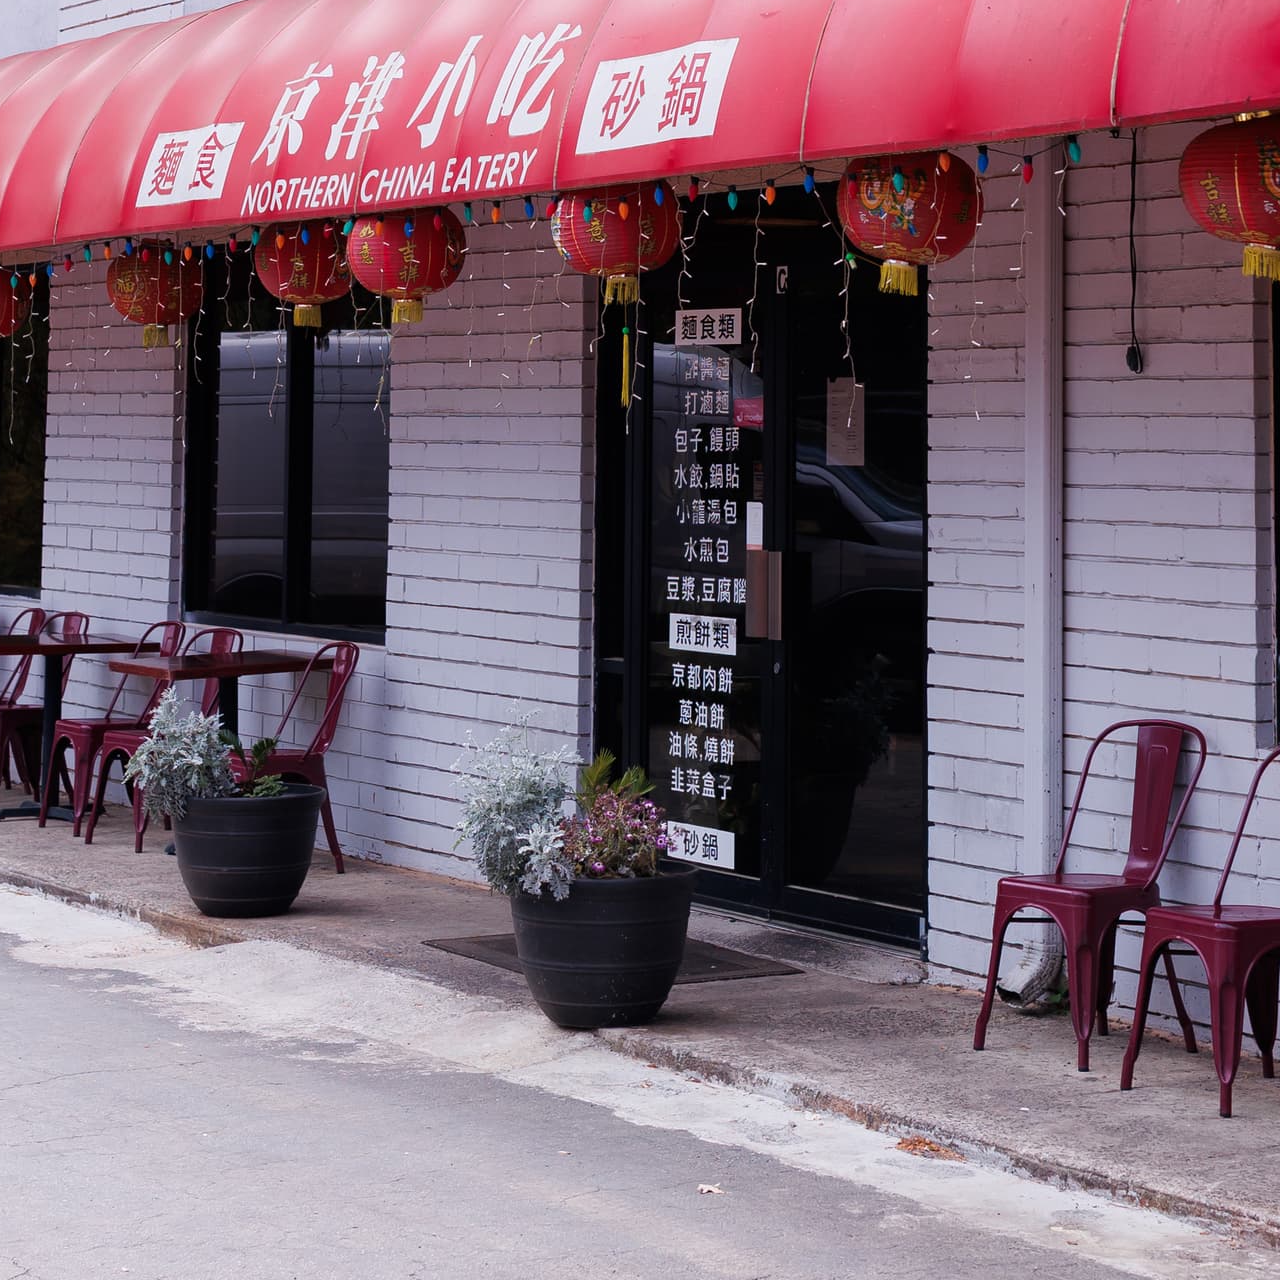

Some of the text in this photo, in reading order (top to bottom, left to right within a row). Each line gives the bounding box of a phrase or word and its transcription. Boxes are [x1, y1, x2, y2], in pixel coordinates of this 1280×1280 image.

[251, 23, 581, 166] 京津小吃
[600, 51, 711, 139] 砂鍋
[148, 130, 224, 197] 麵食
[240, 148, 537, 217] NORTHERN CHINA EATERY
[681, 313, 736, 340] 麵食類
[676, 499, 738, 525] 小籠湯包
[683, 536, 730, 563] 水煎包
[676, 618, 730, 648] 煎餅類
[672, 661, 733, 695] 京都肉餅
[671, 768, 733, 801] 韭菜盒子
[683, 829, 719, 862] 砂鍋
